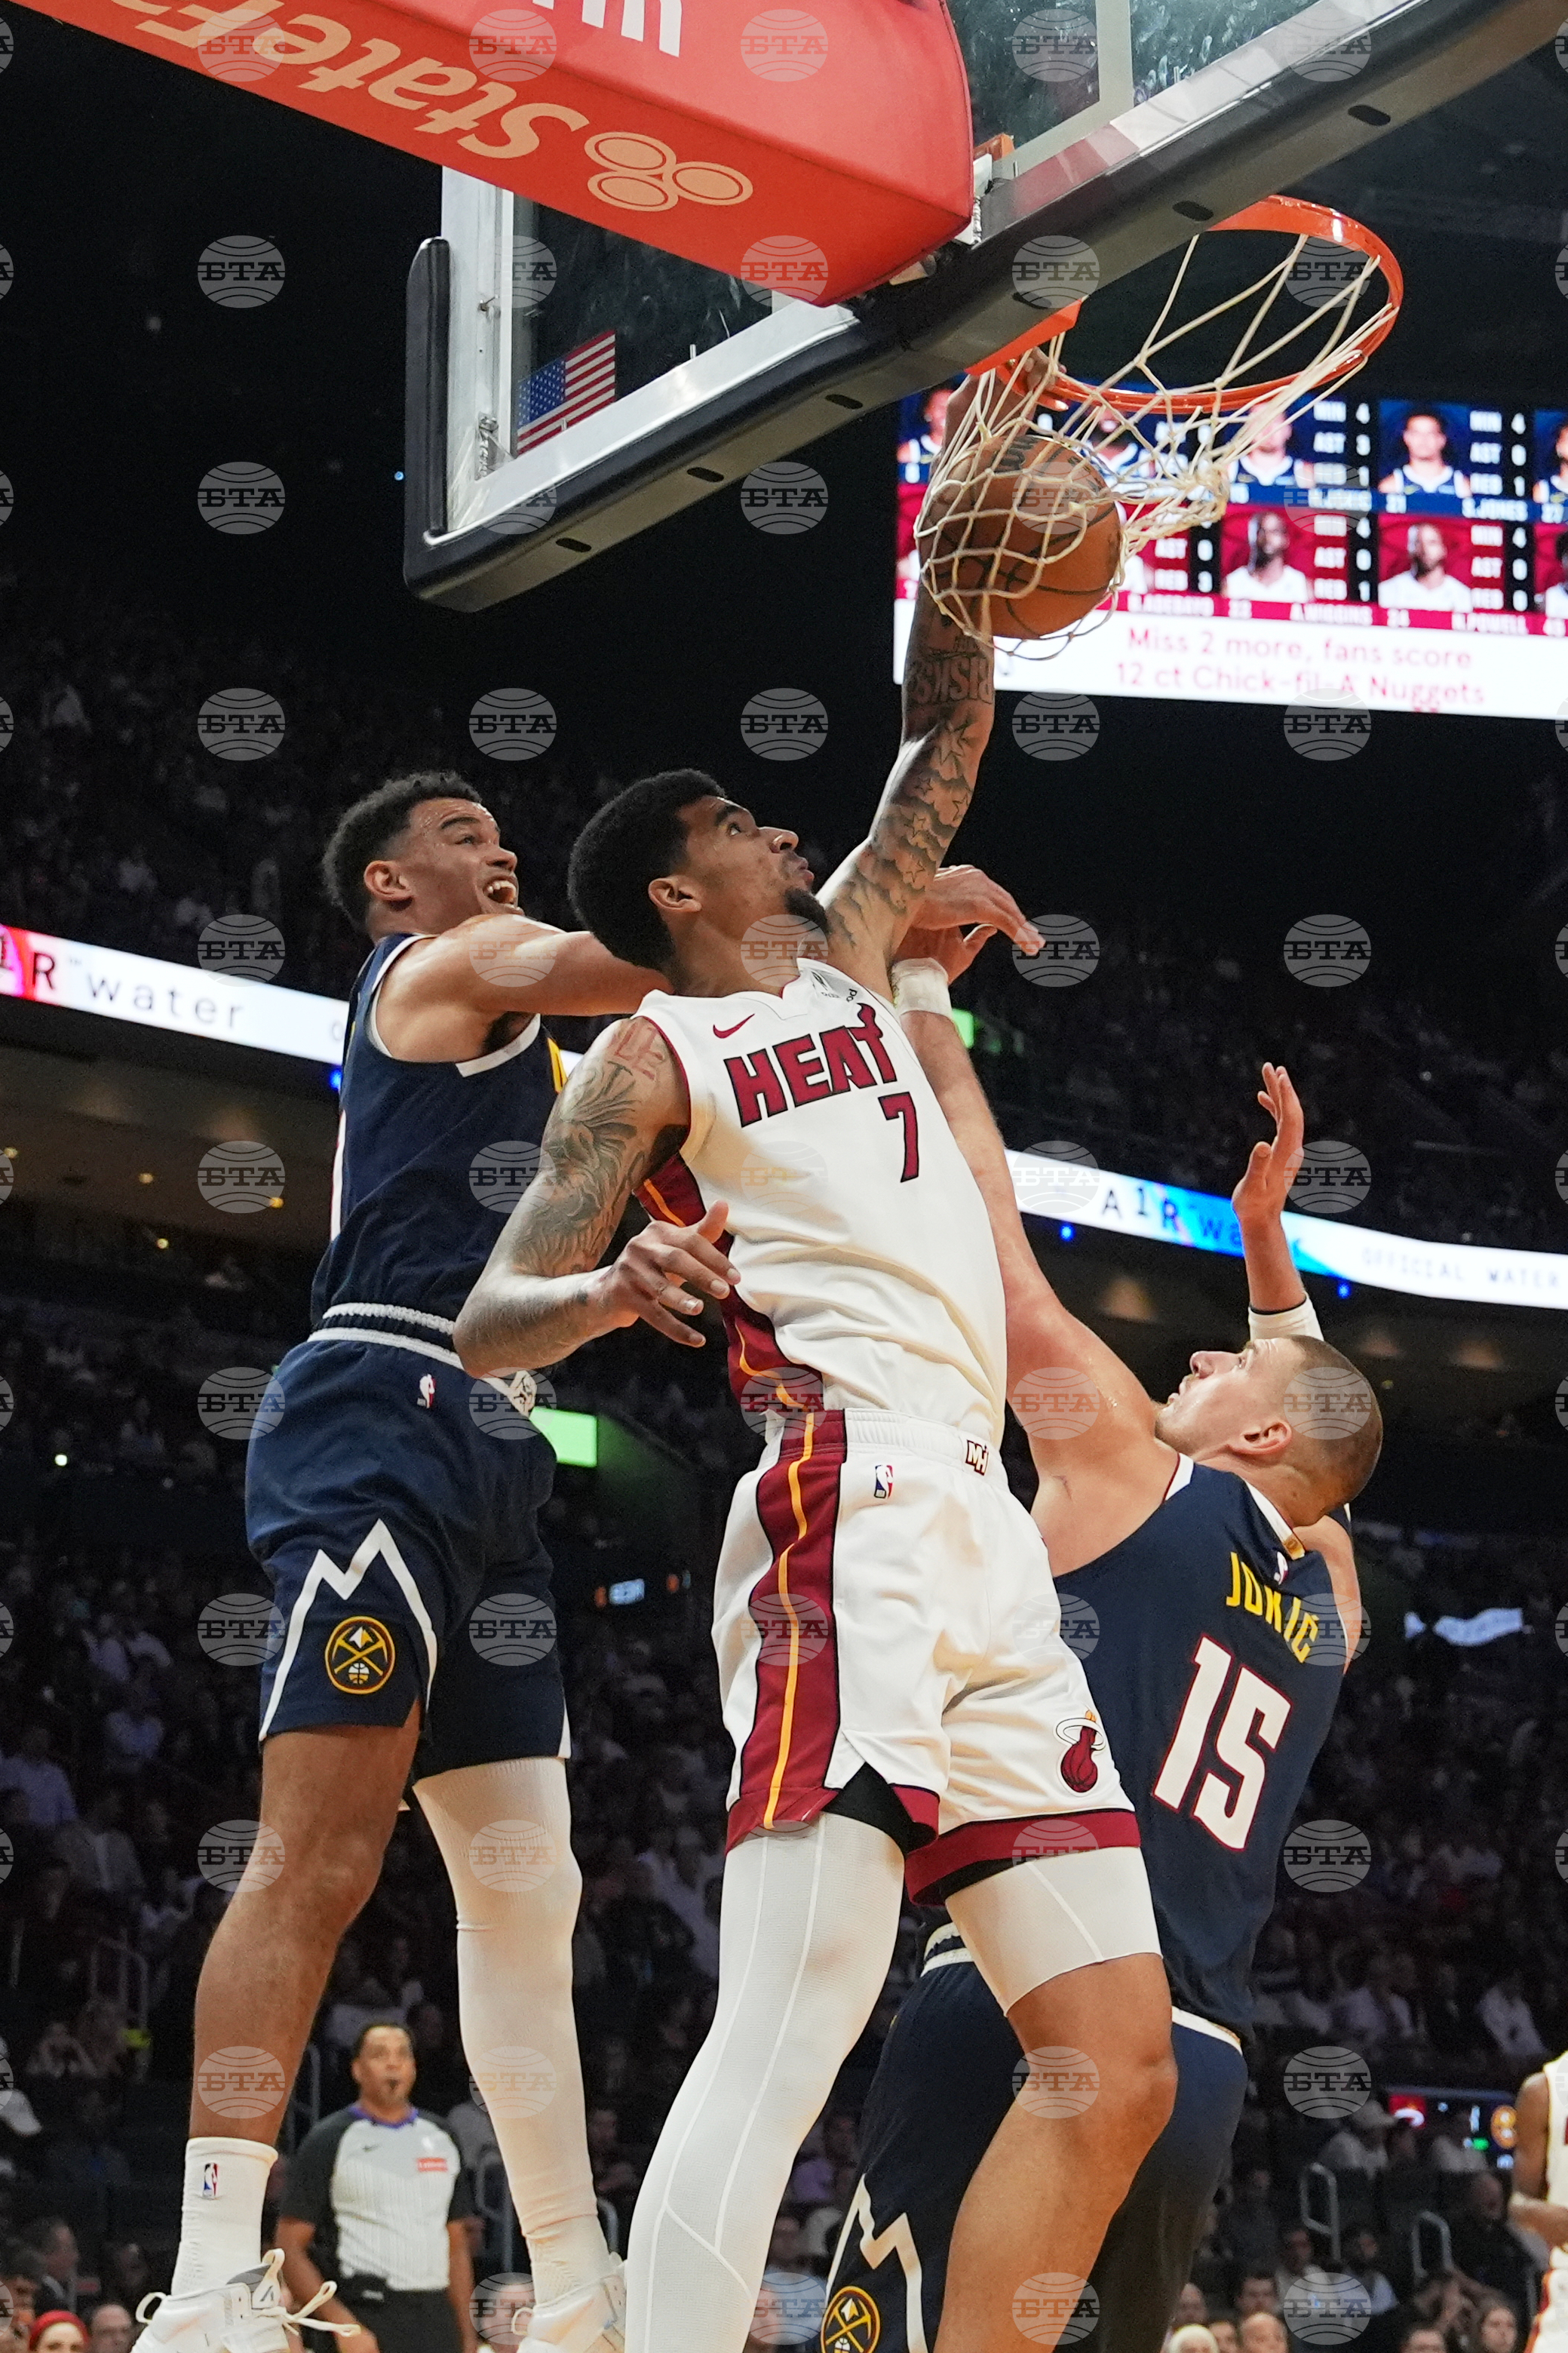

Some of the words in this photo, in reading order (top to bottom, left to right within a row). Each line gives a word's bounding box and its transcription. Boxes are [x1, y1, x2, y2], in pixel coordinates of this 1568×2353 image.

[1314, 401, 1346, 422] MIN
[1356, 403, 1370, 424] 4
[1470, 410, 1502, 433] MIN
[1511, 413, 1526, 435] 4
[1129, 628, 1187, 652] Miss
[1202, 631, 1215, 654] 2
[1226, 638, 1312, 662] more,
[1325, 639, 1381, 663] fans
[1394, 648, 1471, 668] score
[1118, 662, 1143, 687] 12
[1155, 668, 1182, 688] ct
[1370, 676, 1484, 713] Nuggets
[87, 972, 244, 1031] water
[723, 1003, 898, 1128] HEAT
[878, 1091, 919, 1183] 7
[1486, 1266, 1563, 1290] WATER
[1151, 1632, 1294, 1853] 15
